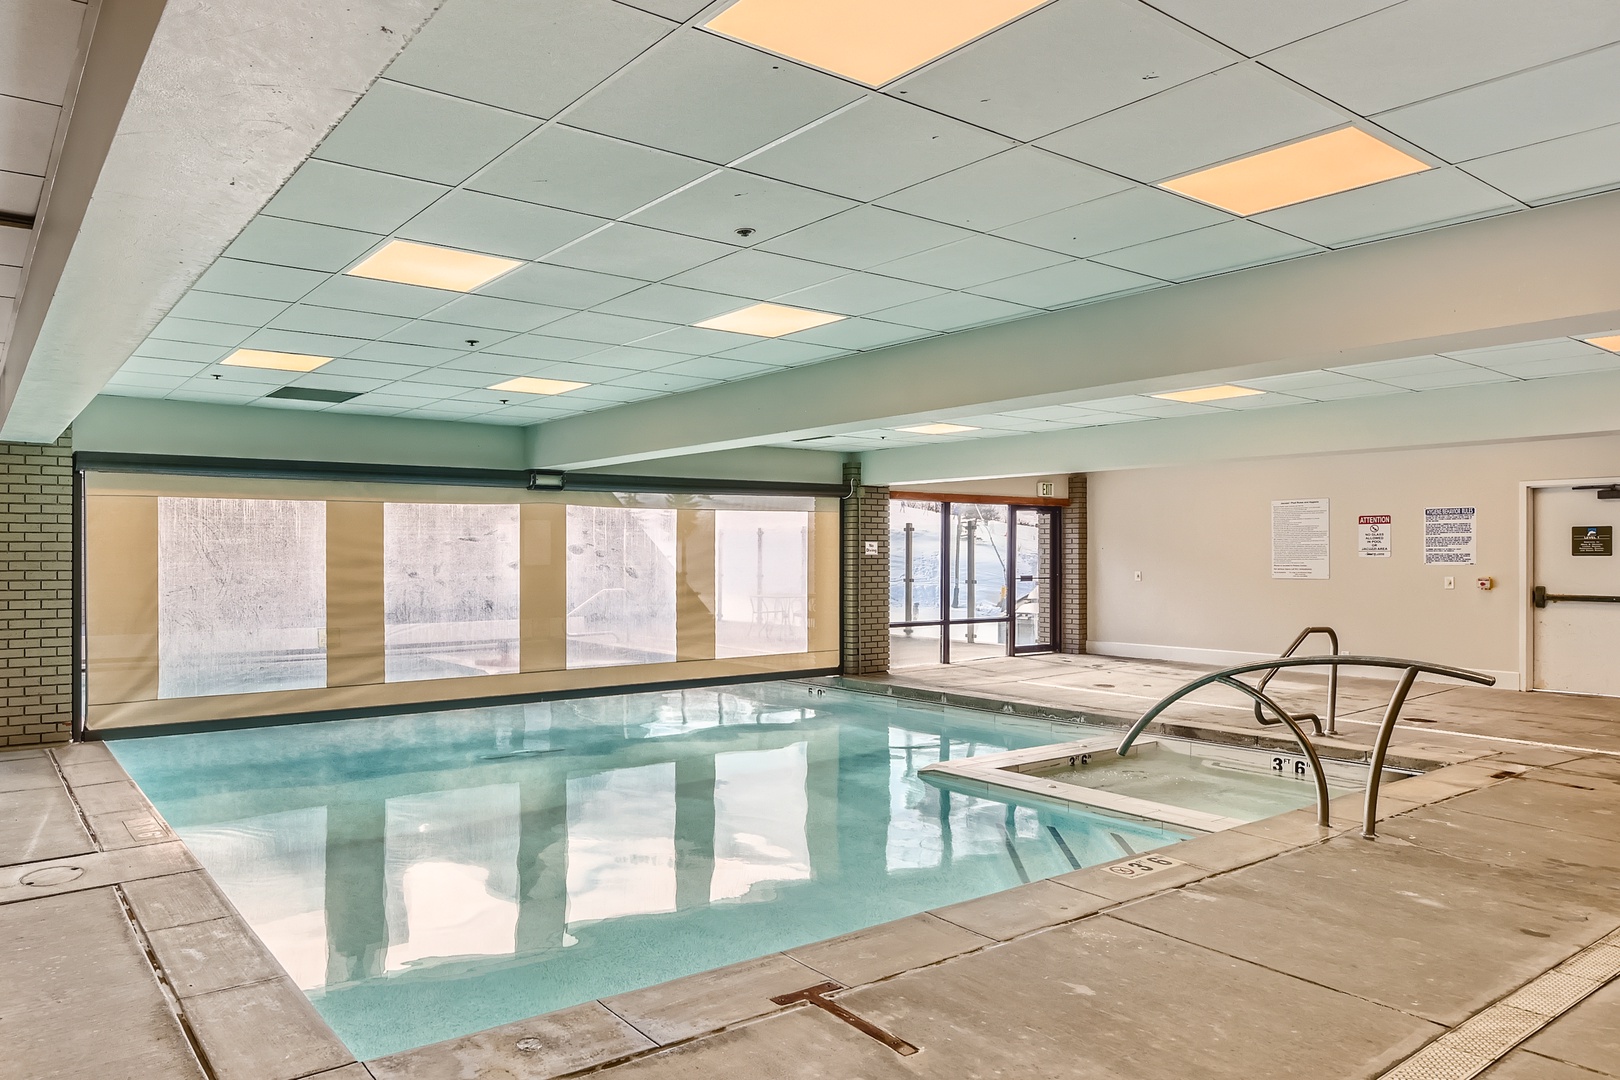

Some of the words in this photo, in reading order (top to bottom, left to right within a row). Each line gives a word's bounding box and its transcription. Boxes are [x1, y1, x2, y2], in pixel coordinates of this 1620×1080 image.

[1042, 483, 1052, 495] EXIT
[1272, 757, 1283, 772] 3
[1294, 760, 1306, 774] 6
[1128, 862, 1154, 871] 3
[1146, 857, 1173, 865] 6
